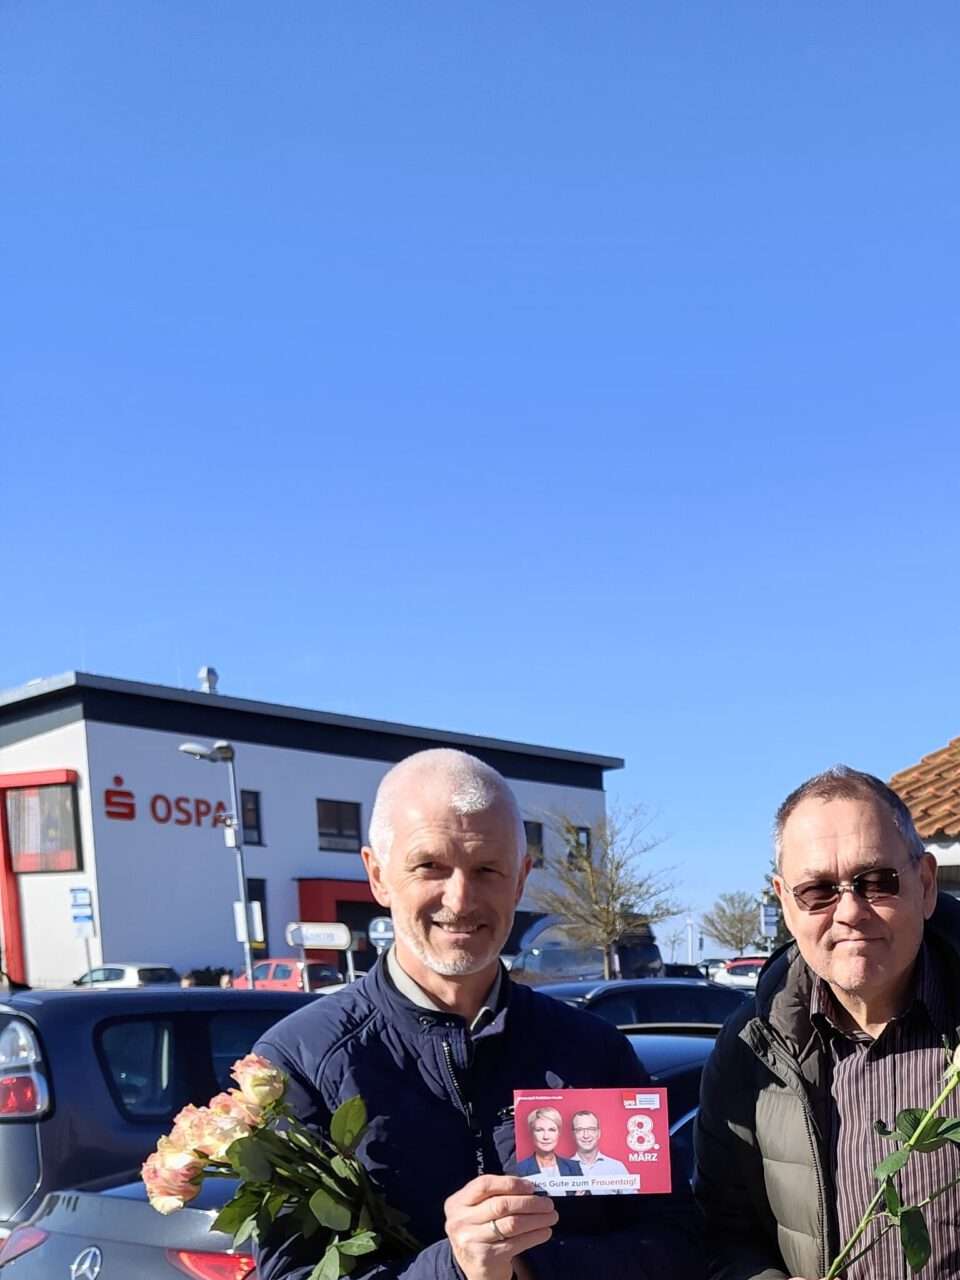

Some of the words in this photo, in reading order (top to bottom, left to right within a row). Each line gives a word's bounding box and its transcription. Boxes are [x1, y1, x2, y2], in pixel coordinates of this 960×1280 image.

[151, 794, 231, 828] OSPA
[629, 1151, 658, 1162] MÄRZ
[549, 1179, 569, 1188] Gute
[591, 1178, 637, 1188] Frauentag!
